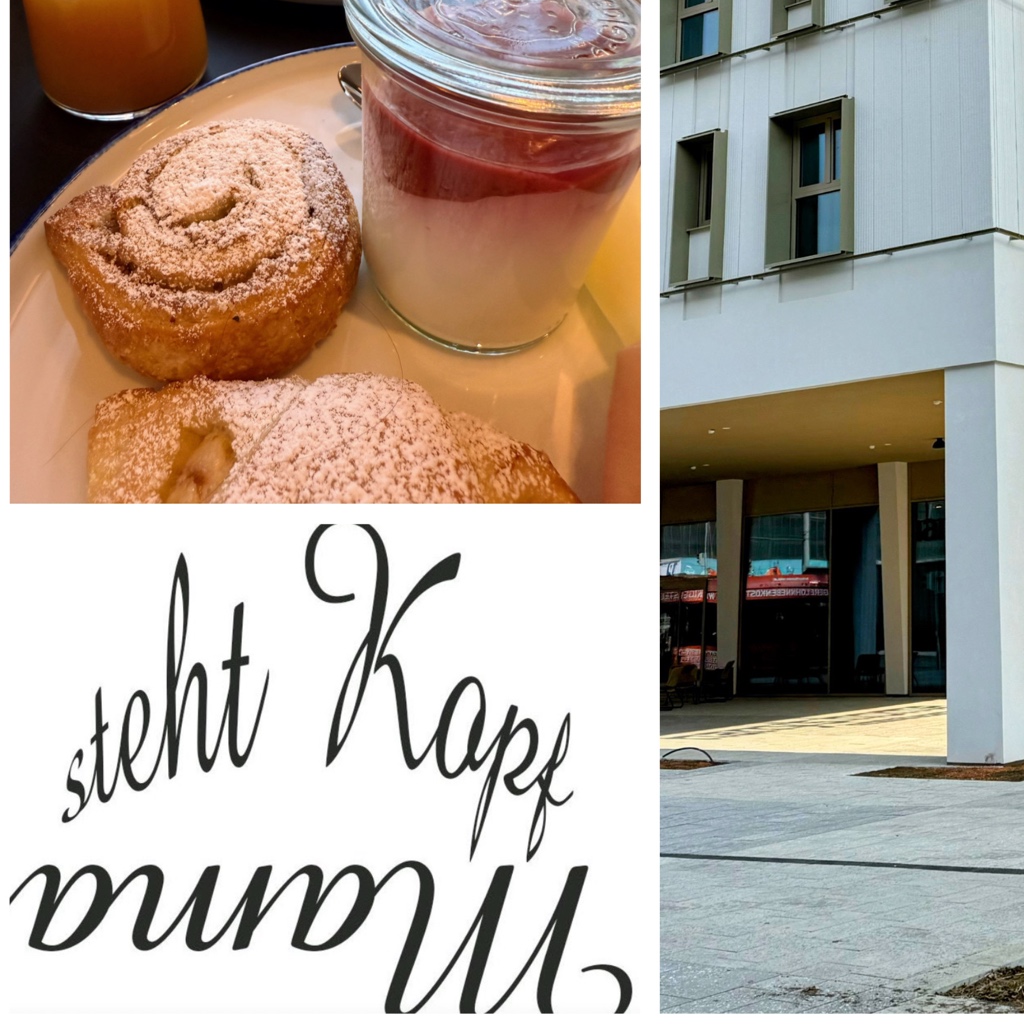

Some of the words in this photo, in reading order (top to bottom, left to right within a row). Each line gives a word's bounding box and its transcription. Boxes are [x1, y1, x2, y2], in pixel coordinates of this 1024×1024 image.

[62, 552, 270, 824] steht
[305, 524, 574, 863] Kopf
[11, 861, 633, 1014] Mama
